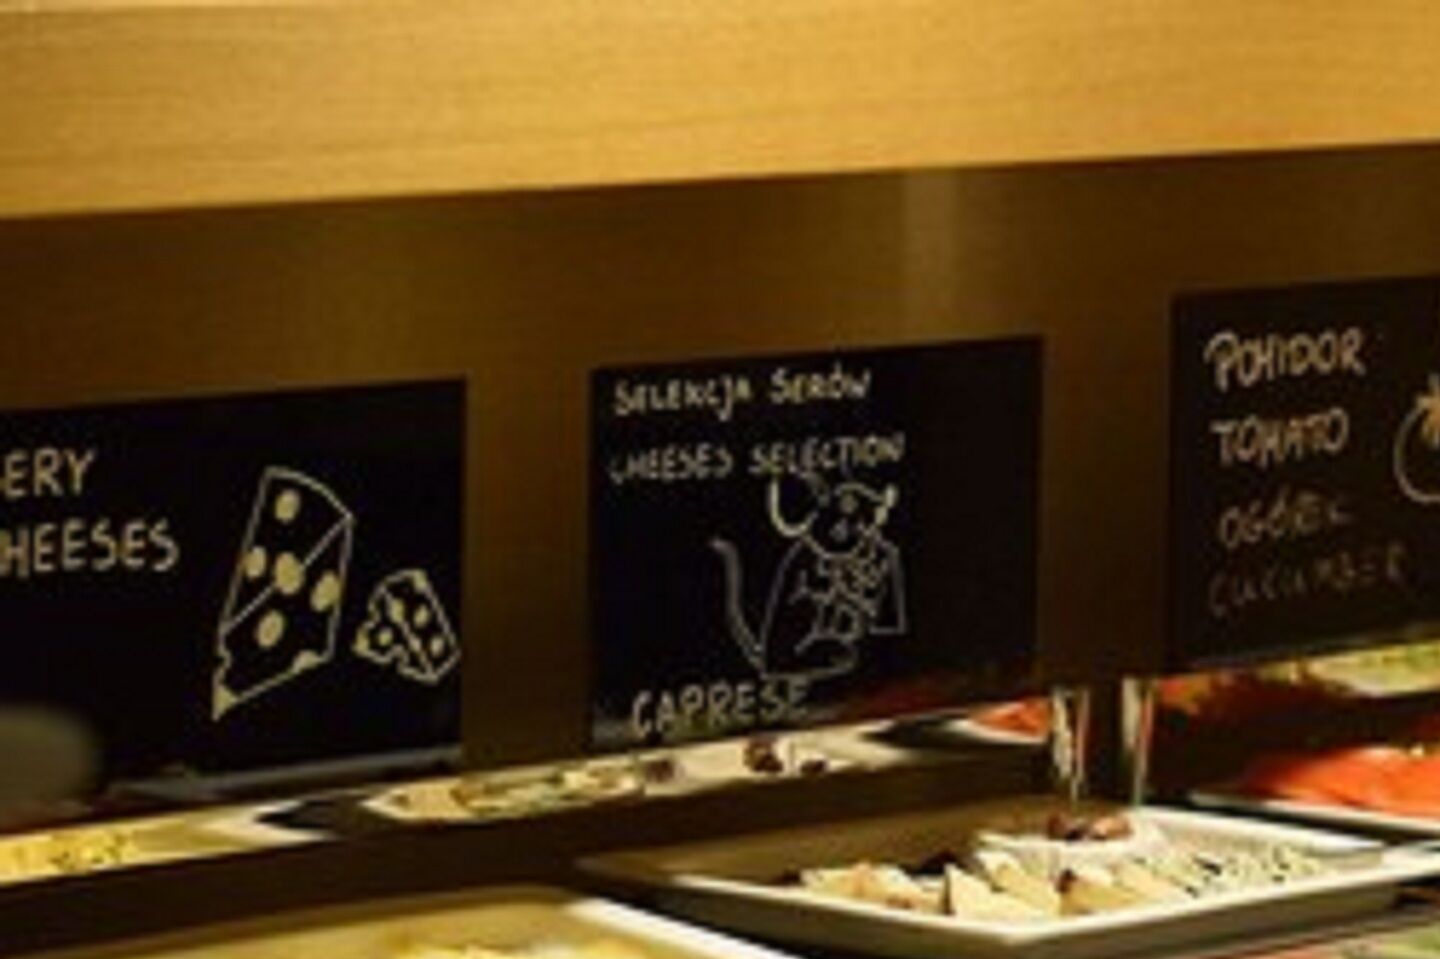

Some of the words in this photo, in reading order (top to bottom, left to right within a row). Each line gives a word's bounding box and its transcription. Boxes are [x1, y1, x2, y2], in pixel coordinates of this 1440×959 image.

[0, 447, 97, 500] ERY
[748, 431, 906, 478] SELECTION
[631, 677, 808, 737] CAPRESE
